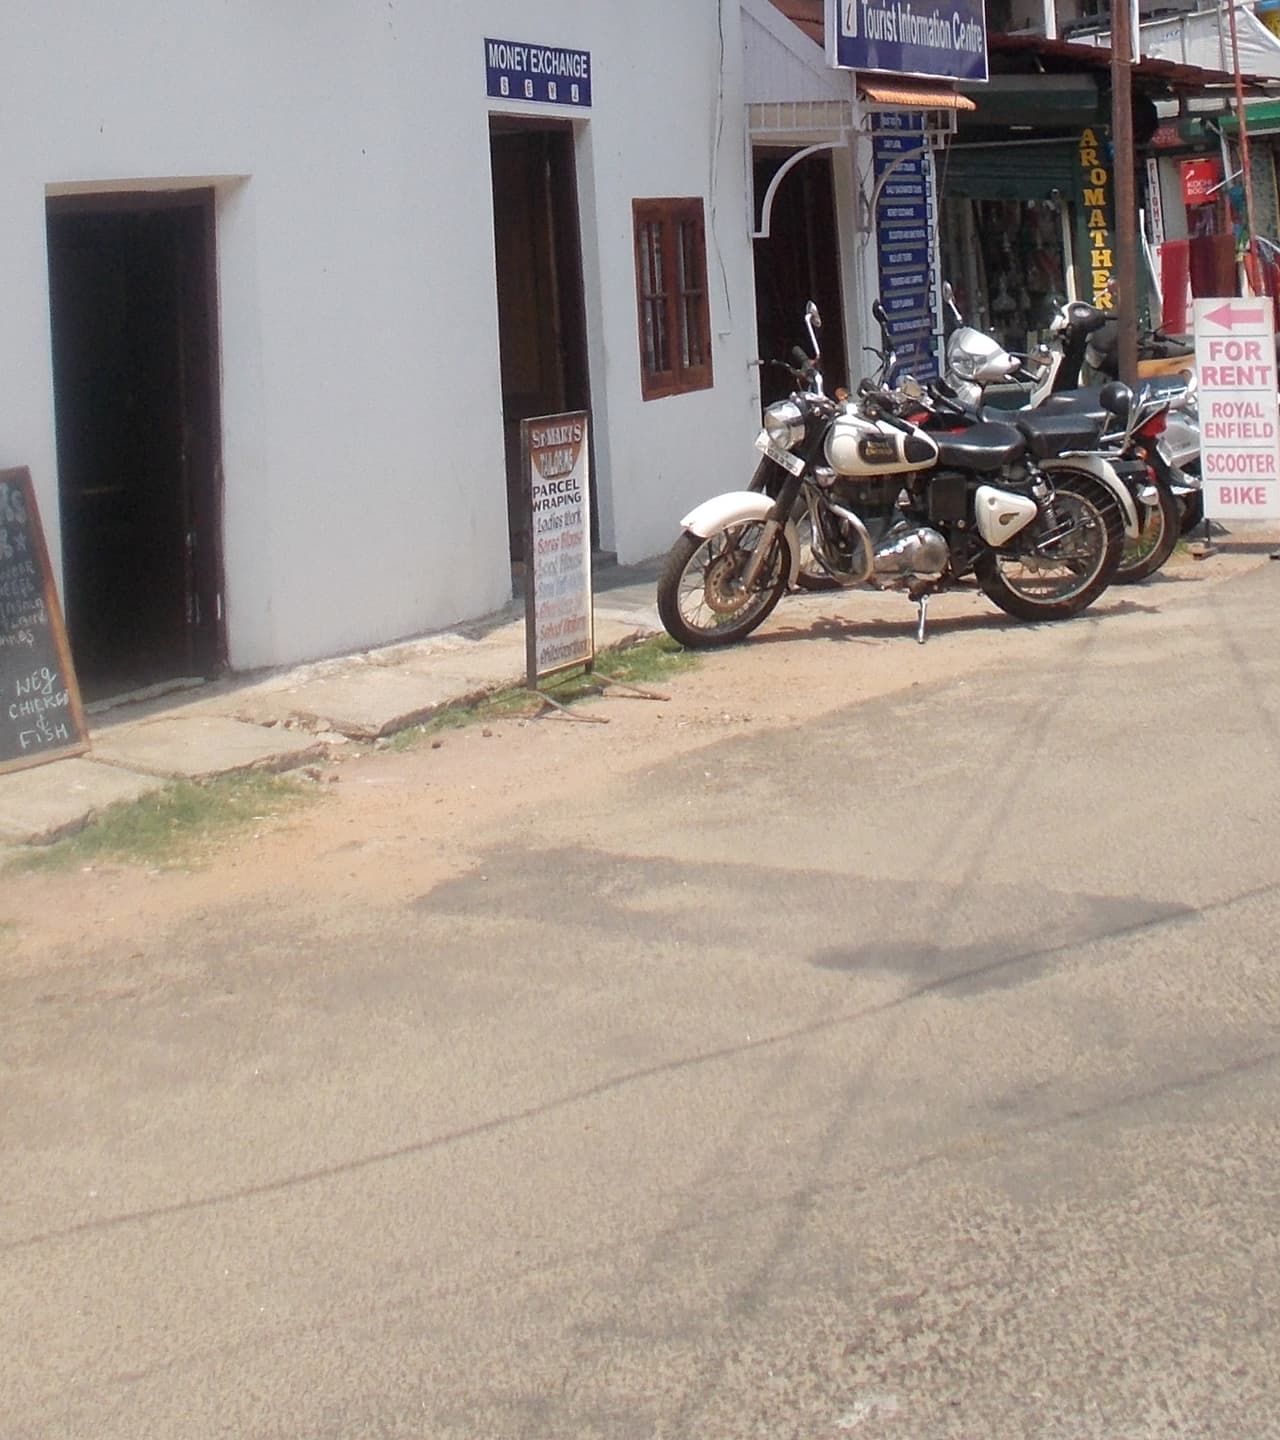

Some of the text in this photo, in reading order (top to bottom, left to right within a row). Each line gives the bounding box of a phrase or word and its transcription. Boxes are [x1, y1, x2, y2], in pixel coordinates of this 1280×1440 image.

[898, 2, 951, 49] Information
[952, 11, 983, 54] Centre
[488, 43, 589, 79] MONEY EXCHANGE
[1209, 340, 1262, 361] FOR
[1201, 365, 1272, 386] RENT
[1211, 401, 1265, 418] ROYAL
[1205, 422, 1274, 439] ENFIELD
[1206, 453, 1276, 474] SCOOTER
[532, 478, 581, 500] PARCEL
[1219, 486, 1267, 505] BIKE
[531, 491, 583, 513] WRAPING
[19, 723, 69, 749] FISH
